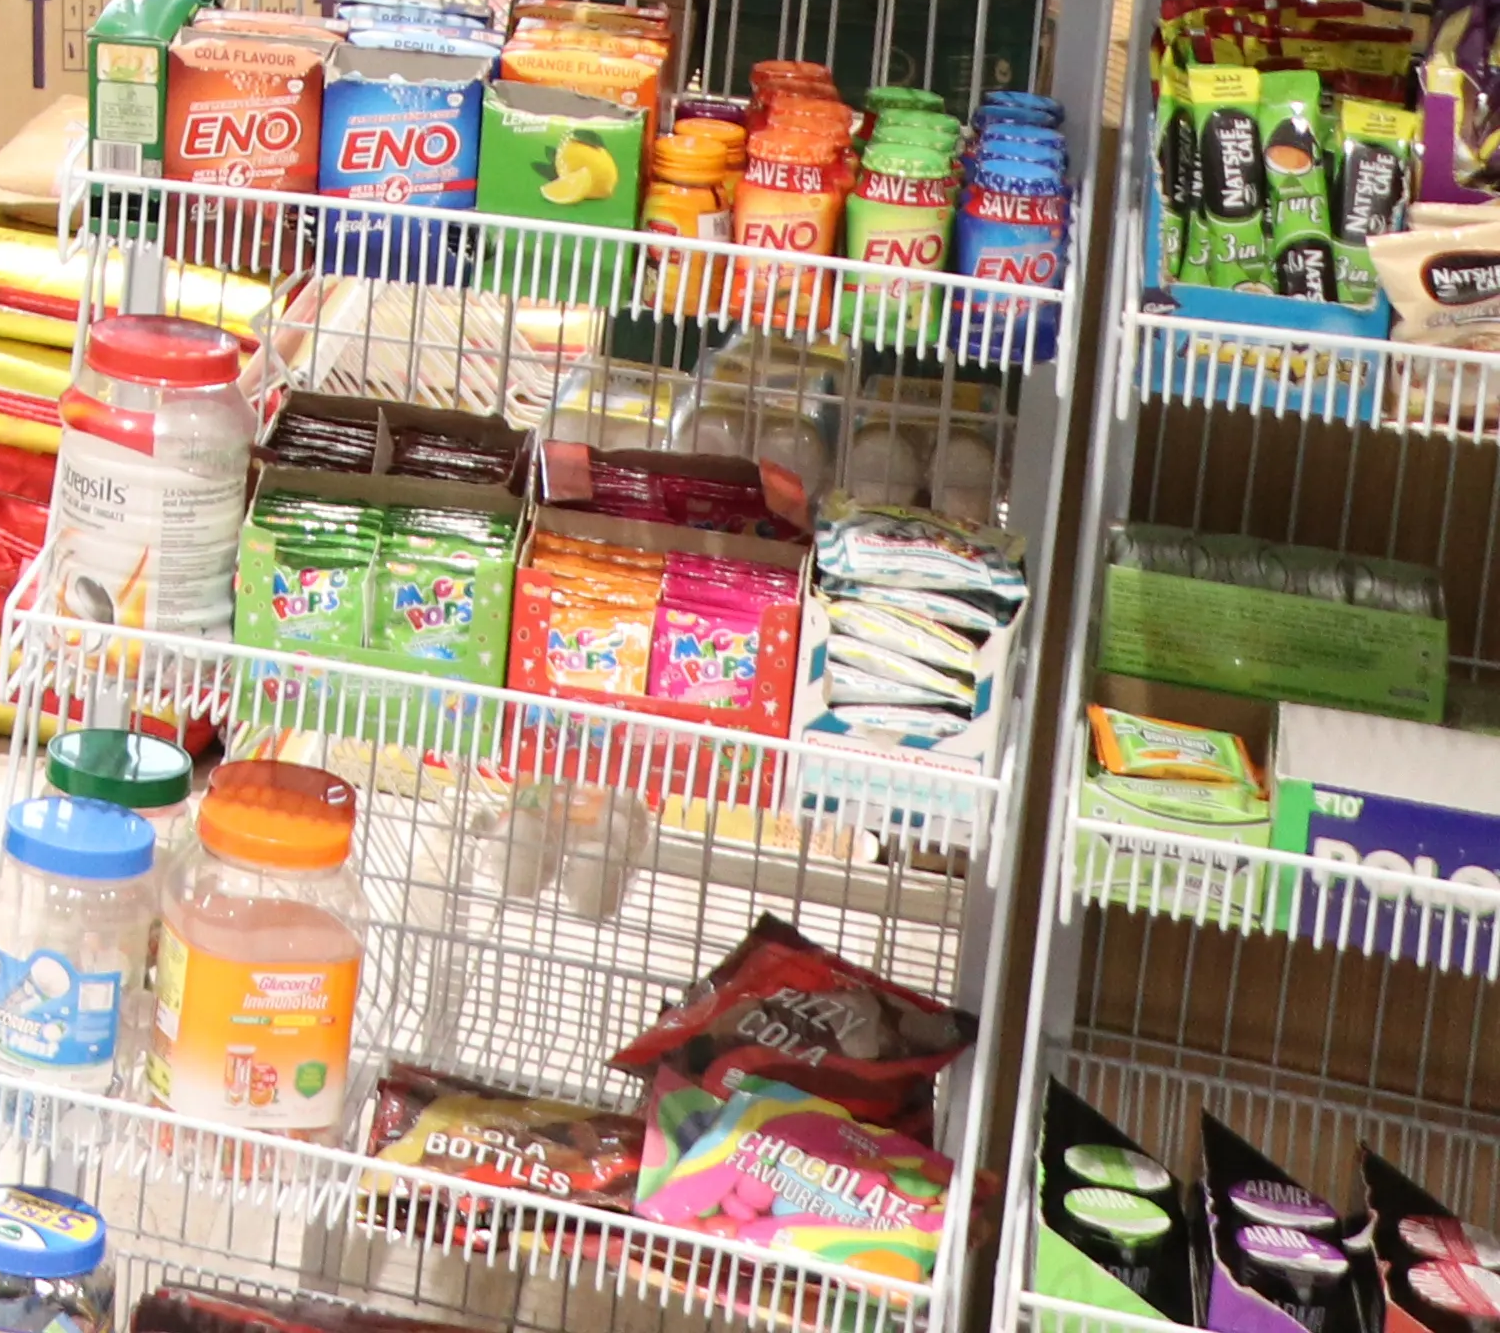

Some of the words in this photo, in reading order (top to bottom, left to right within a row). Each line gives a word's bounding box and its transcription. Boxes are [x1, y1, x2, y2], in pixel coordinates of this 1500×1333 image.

[193, 47, 230, 62] COLA
[232, 49, 297, 67] FLAVOUR
[517, 56, 572, 74] ORANGE
[575, 60, 642, 80] FLAVOUR
[179, 107, 303, 160] ENO
[337, 121, 462, 174] ENO
[1234, 117, 1255, 163] CAFE
[745, 158, 789, 190] SAVE
[1221, 128, 1244, 208] NATSHE
[1374, 153, 1395, 195] CAFE
[866, 176, 917, 204] SAVE
[1345, 159, 1378, 233] NATSHE
[979, 194, 1031, 222] SAVE
[742, 220, 819, 252] ENO
[862, 234, 943, 267] ENO
[974, 250, 1058, 284] ENO
[272, 590, 339, 620] POPS
[407, 593, 474, 632] POPS
[684, 653, 757, 685] POPS
[242, 992, 329, 1010] ImmunoVolt
[258, 976, 320, 993] Glucon-D
[775, 985, 864, 1049] FIZZY
[736, 1009, 830, 1069] COLA
[461, 1123, 547, 1162] COLA
[424, 1132, 572, 1197] BOTTLES
[736, 1130, 926, 1225] CHOCOLATE
[724, 1151, 835, 1216] FLAVOURED
[1244, 1180, 1314, 1208] ARMR
[1246, 1226, 1314, 1251] ARMR
